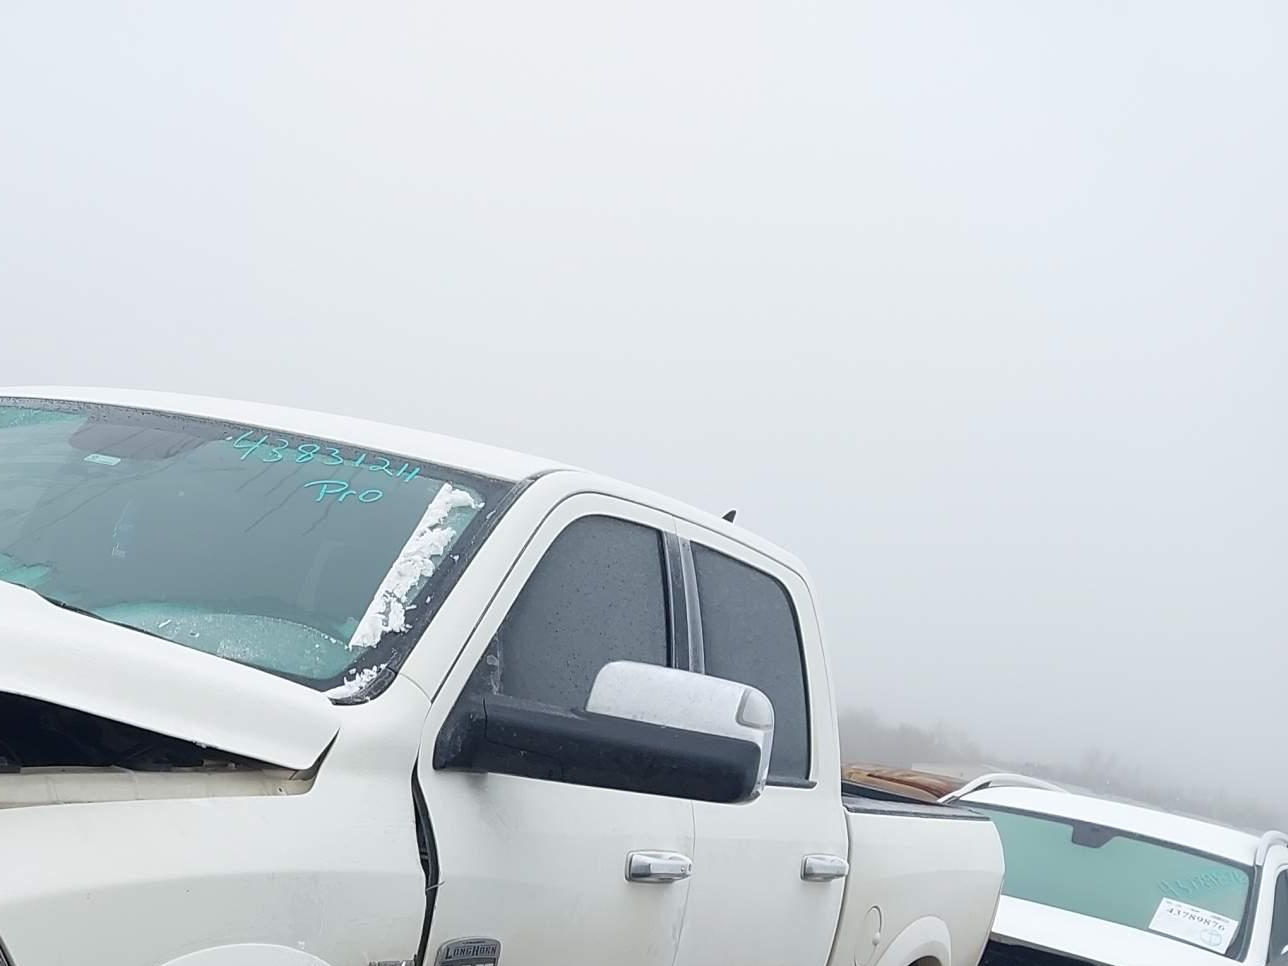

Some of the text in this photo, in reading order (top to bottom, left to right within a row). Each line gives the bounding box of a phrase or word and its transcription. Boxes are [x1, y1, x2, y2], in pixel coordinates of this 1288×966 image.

[232, 430, 421, 483] 43831211
[303, 479, 384, 503] Pro
[1167, 907, 1225, 931] 43789876
